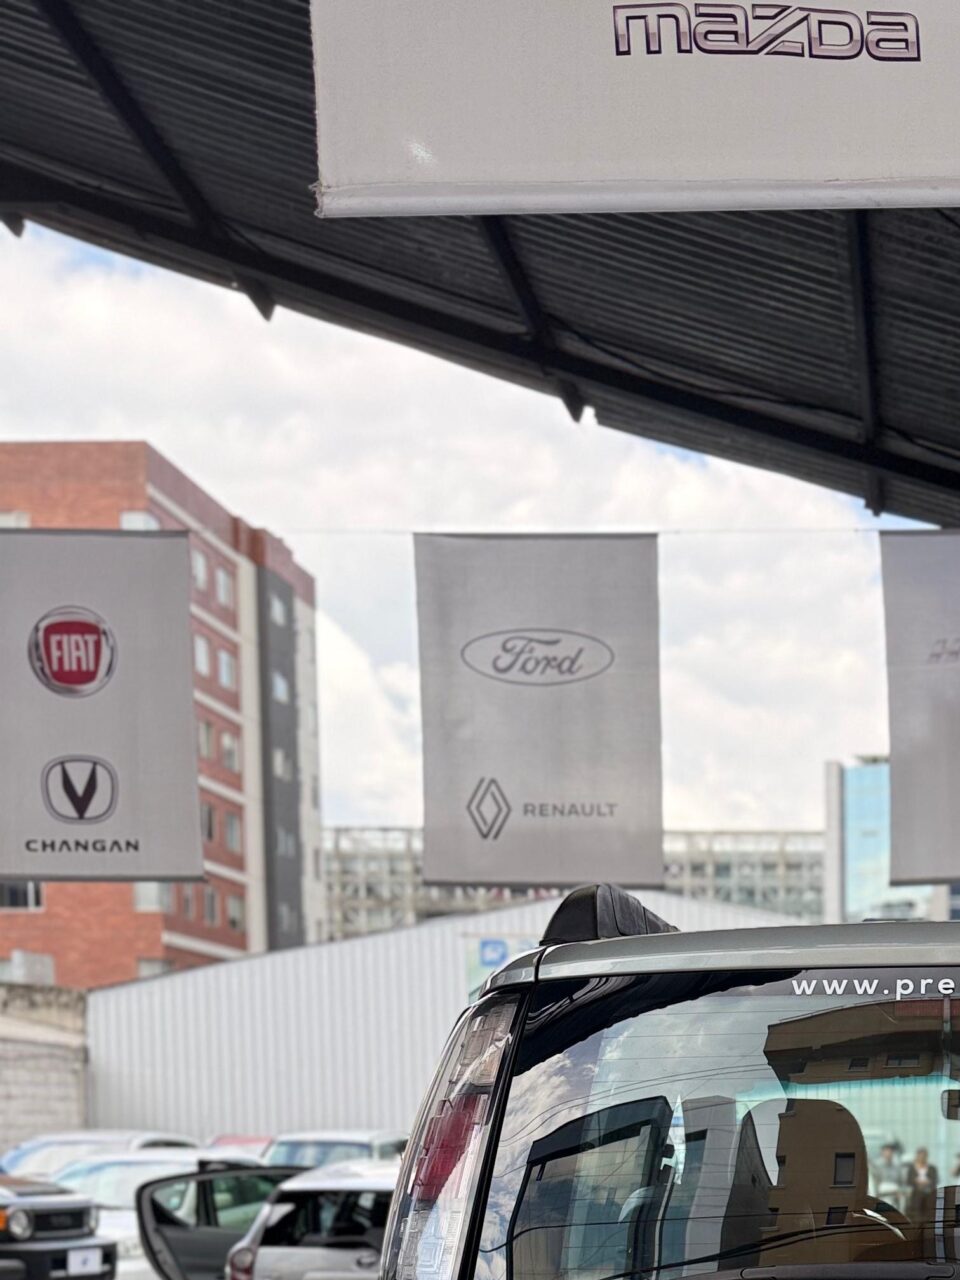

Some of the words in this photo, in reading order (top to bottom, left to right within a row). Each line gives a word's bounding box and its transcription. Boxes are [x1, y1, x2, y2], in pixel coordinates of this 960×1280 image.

[49, 633, 98, 672] FIAT
[492, 635, 585, 675] Ford
[522, 802, 618, 818] RENAULT
[25, 839, 140, 853] CHANGAN
